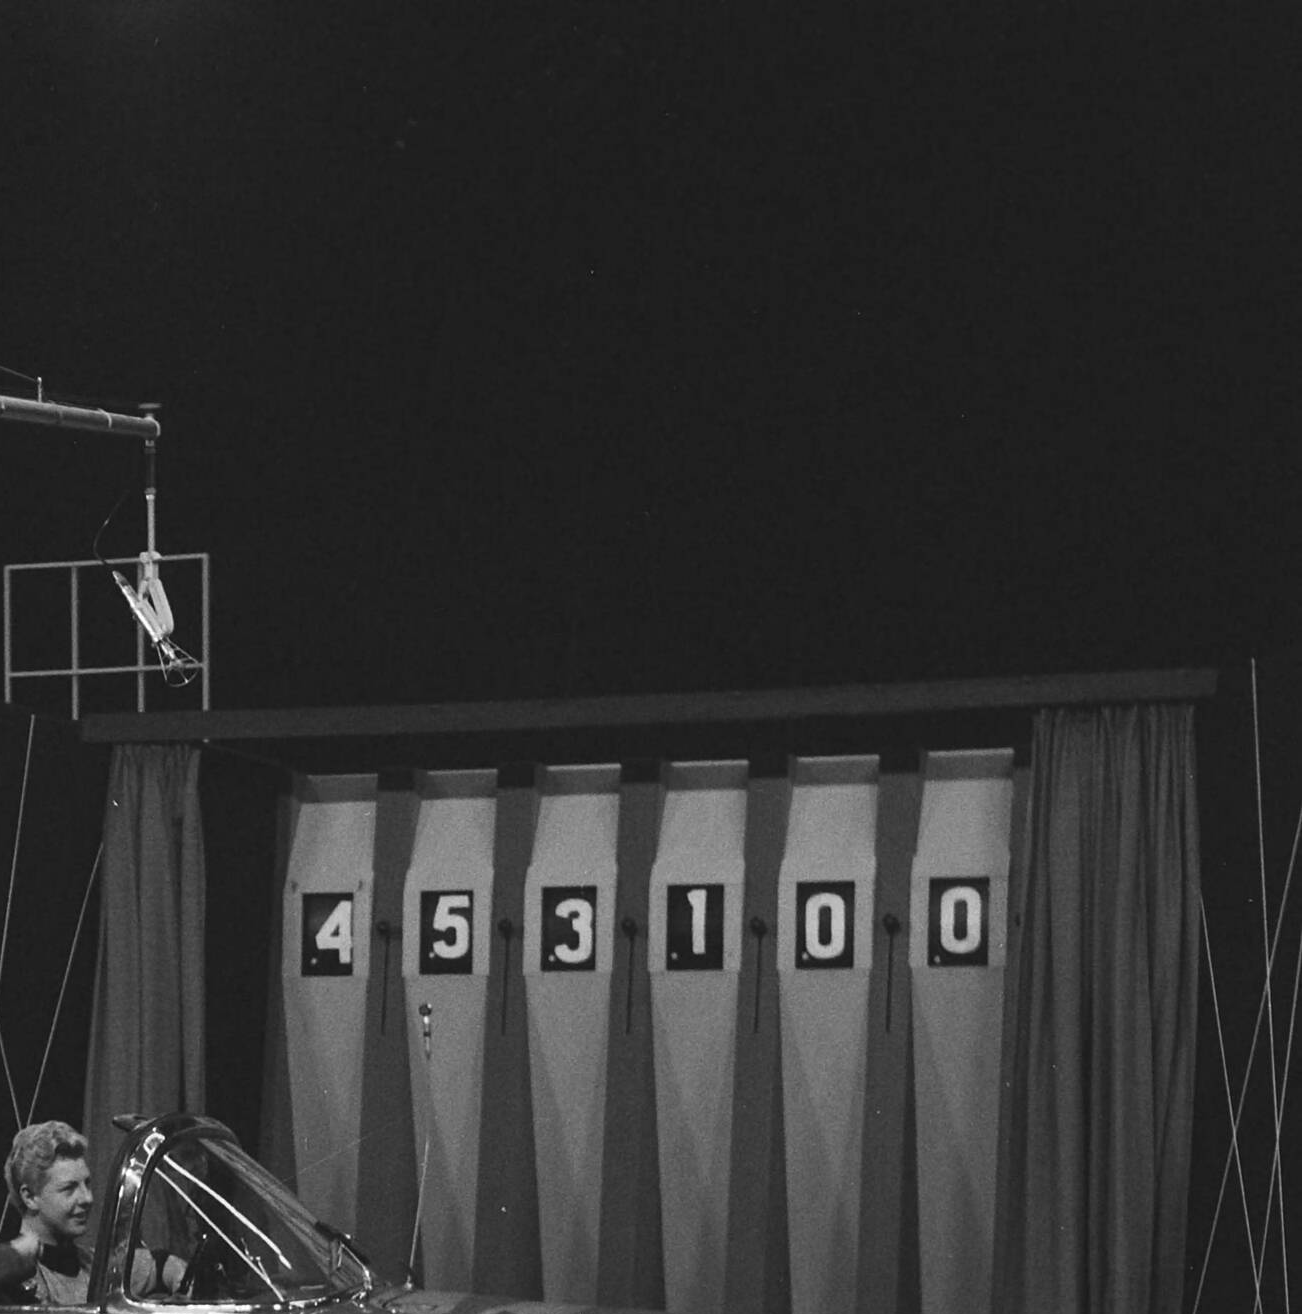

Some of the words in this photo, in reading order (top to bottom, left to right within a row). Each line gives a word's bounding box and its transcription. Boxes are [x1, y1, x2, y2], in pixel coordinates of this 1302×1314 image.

[315, 900, 354, 964] 4
[433, 895, 470, 959] 5
[554, 898, 593, 963] 3
[687, 889, 707, 954] 1
[805, 892, 846, 959] 0
[940, 886, 982, 954] 0
